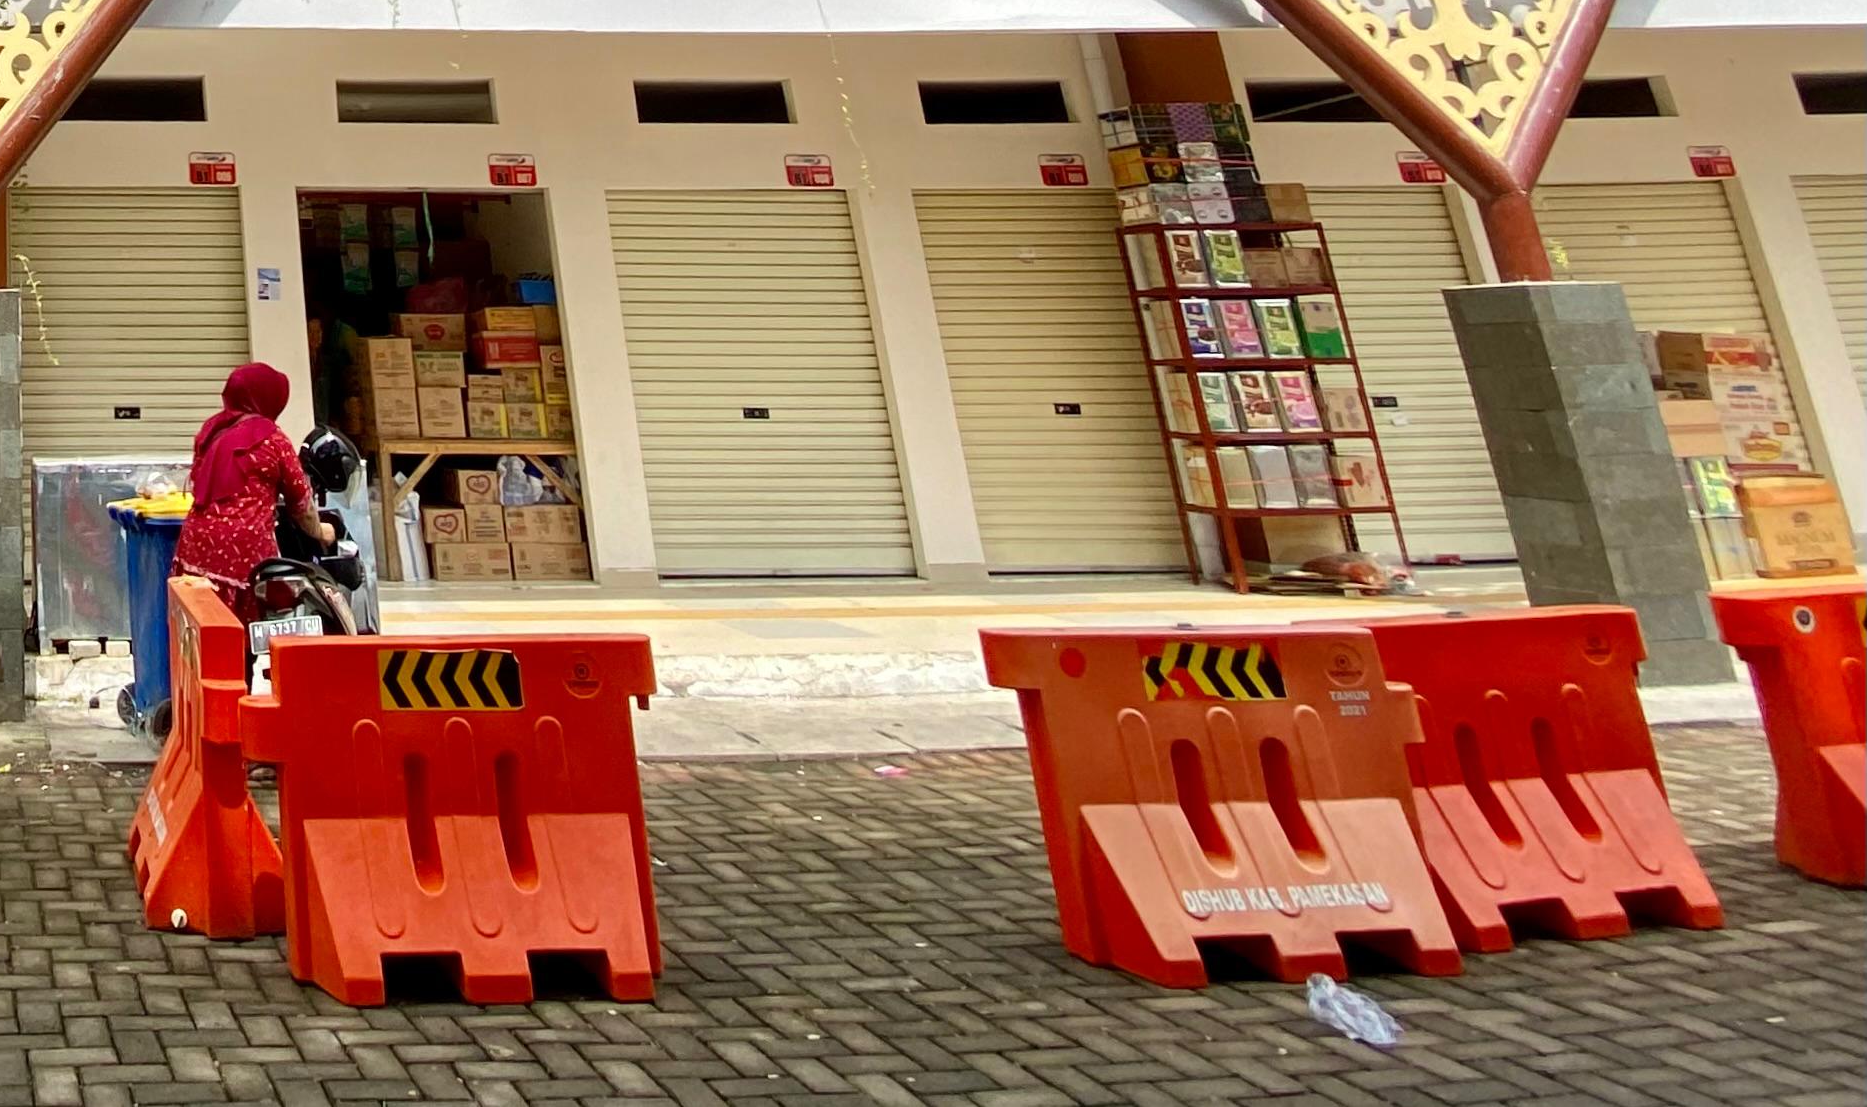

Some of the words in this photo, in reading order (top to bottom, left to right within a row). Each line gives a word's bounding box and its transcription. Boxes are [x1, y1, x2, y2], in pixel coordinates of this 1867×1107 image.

[269, 620, 297, 637] 6737
[1182, 889, 1247, 912] DISHUB
[1287, 882, 1390, 908] PAMEKASAN
